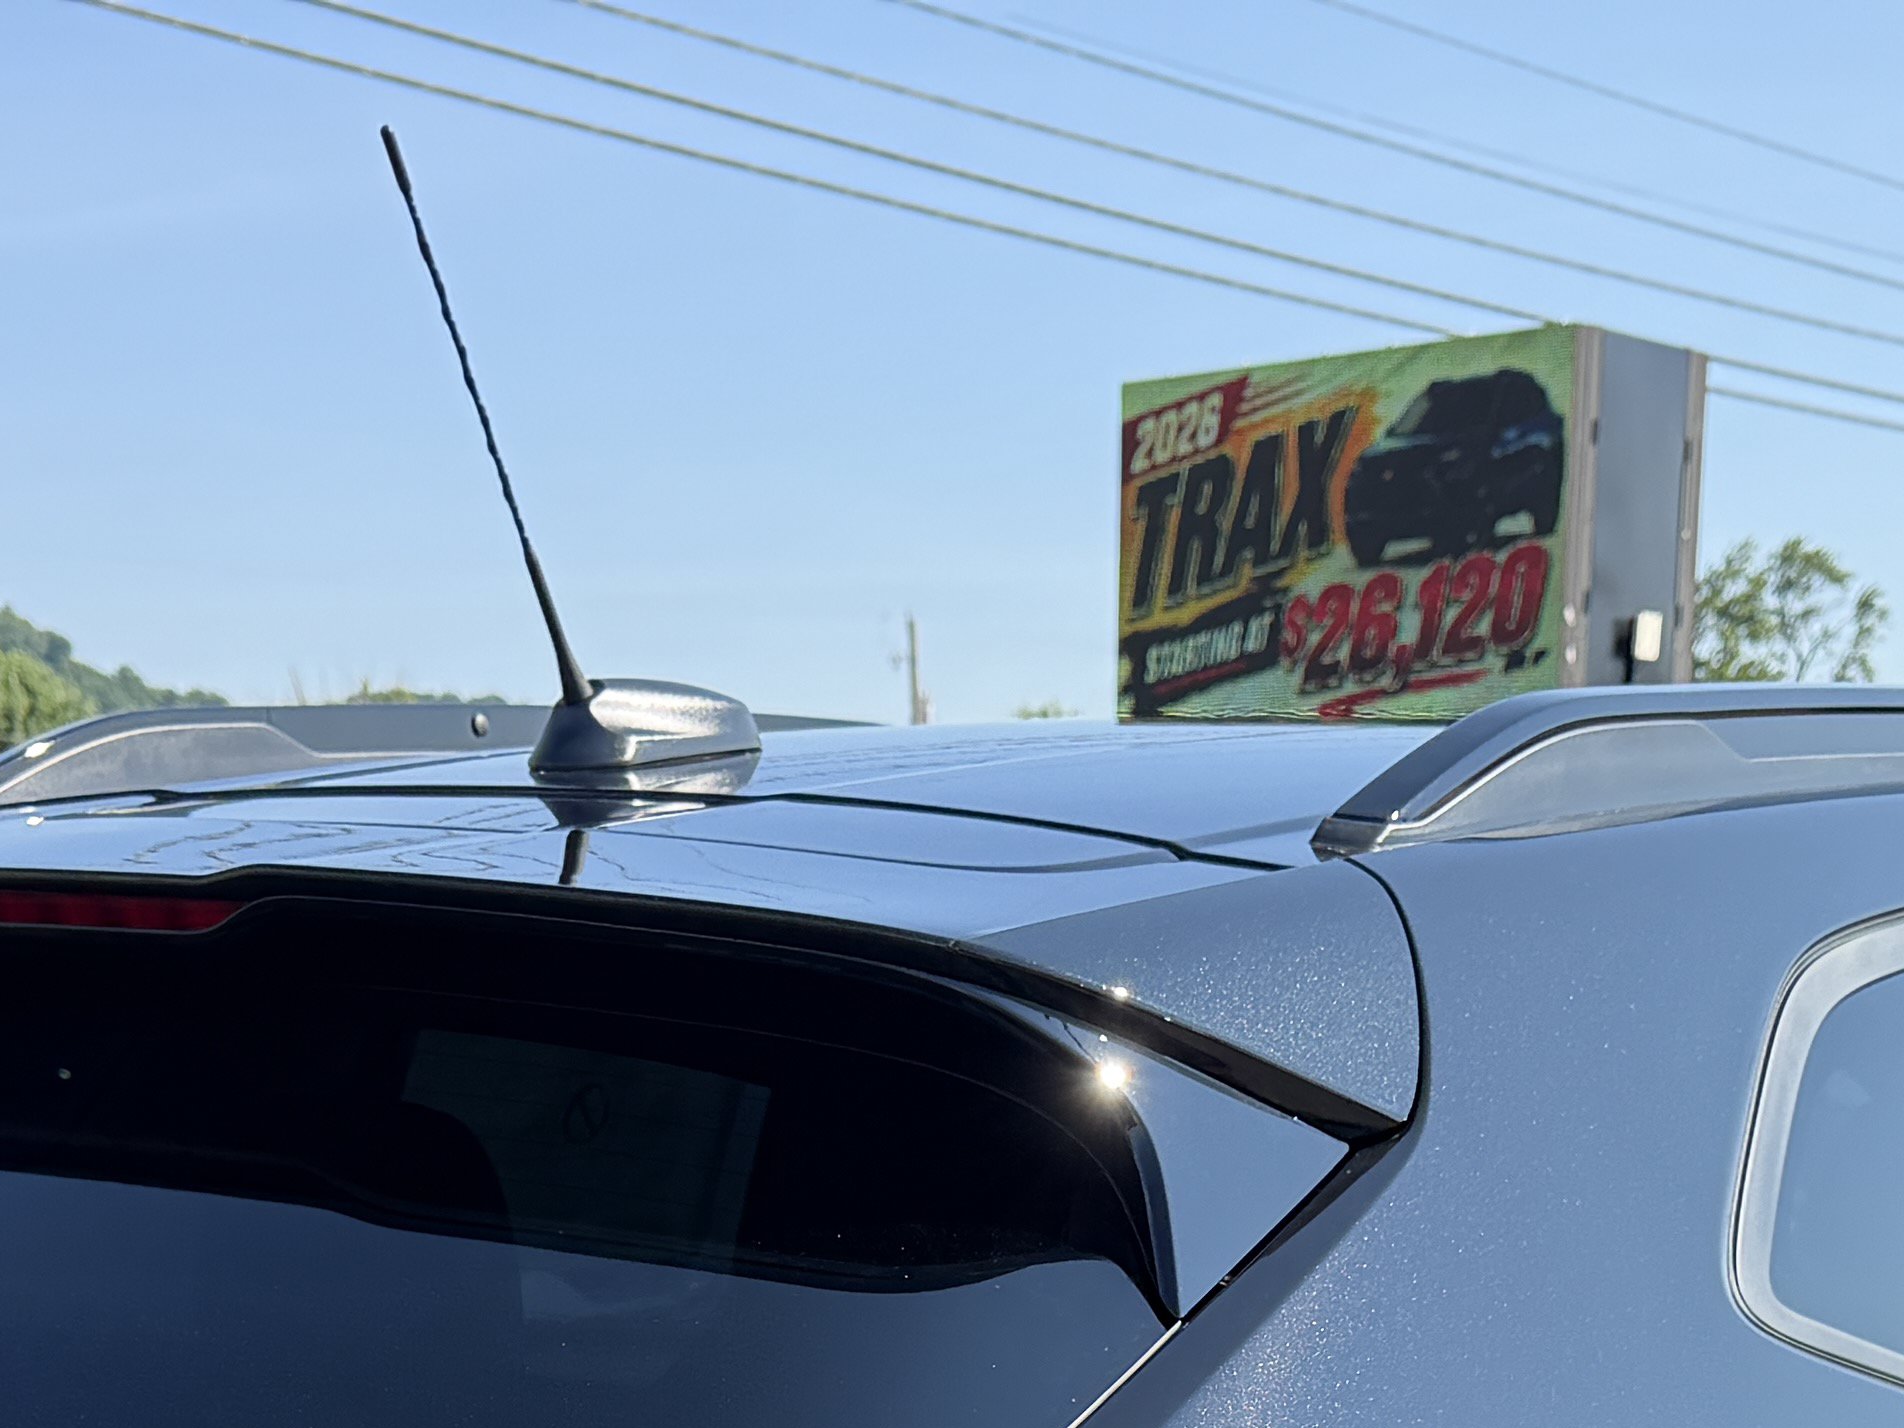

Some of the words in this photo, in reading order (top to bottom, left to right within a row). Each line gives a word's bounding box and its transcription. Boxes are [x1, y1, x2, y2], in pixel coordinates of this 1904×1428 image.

[1130, 390, 1224, 475] 2026
[1130, 405, 1359, 615] TRAX
[1280, 540, 1548, 692] $26,120
